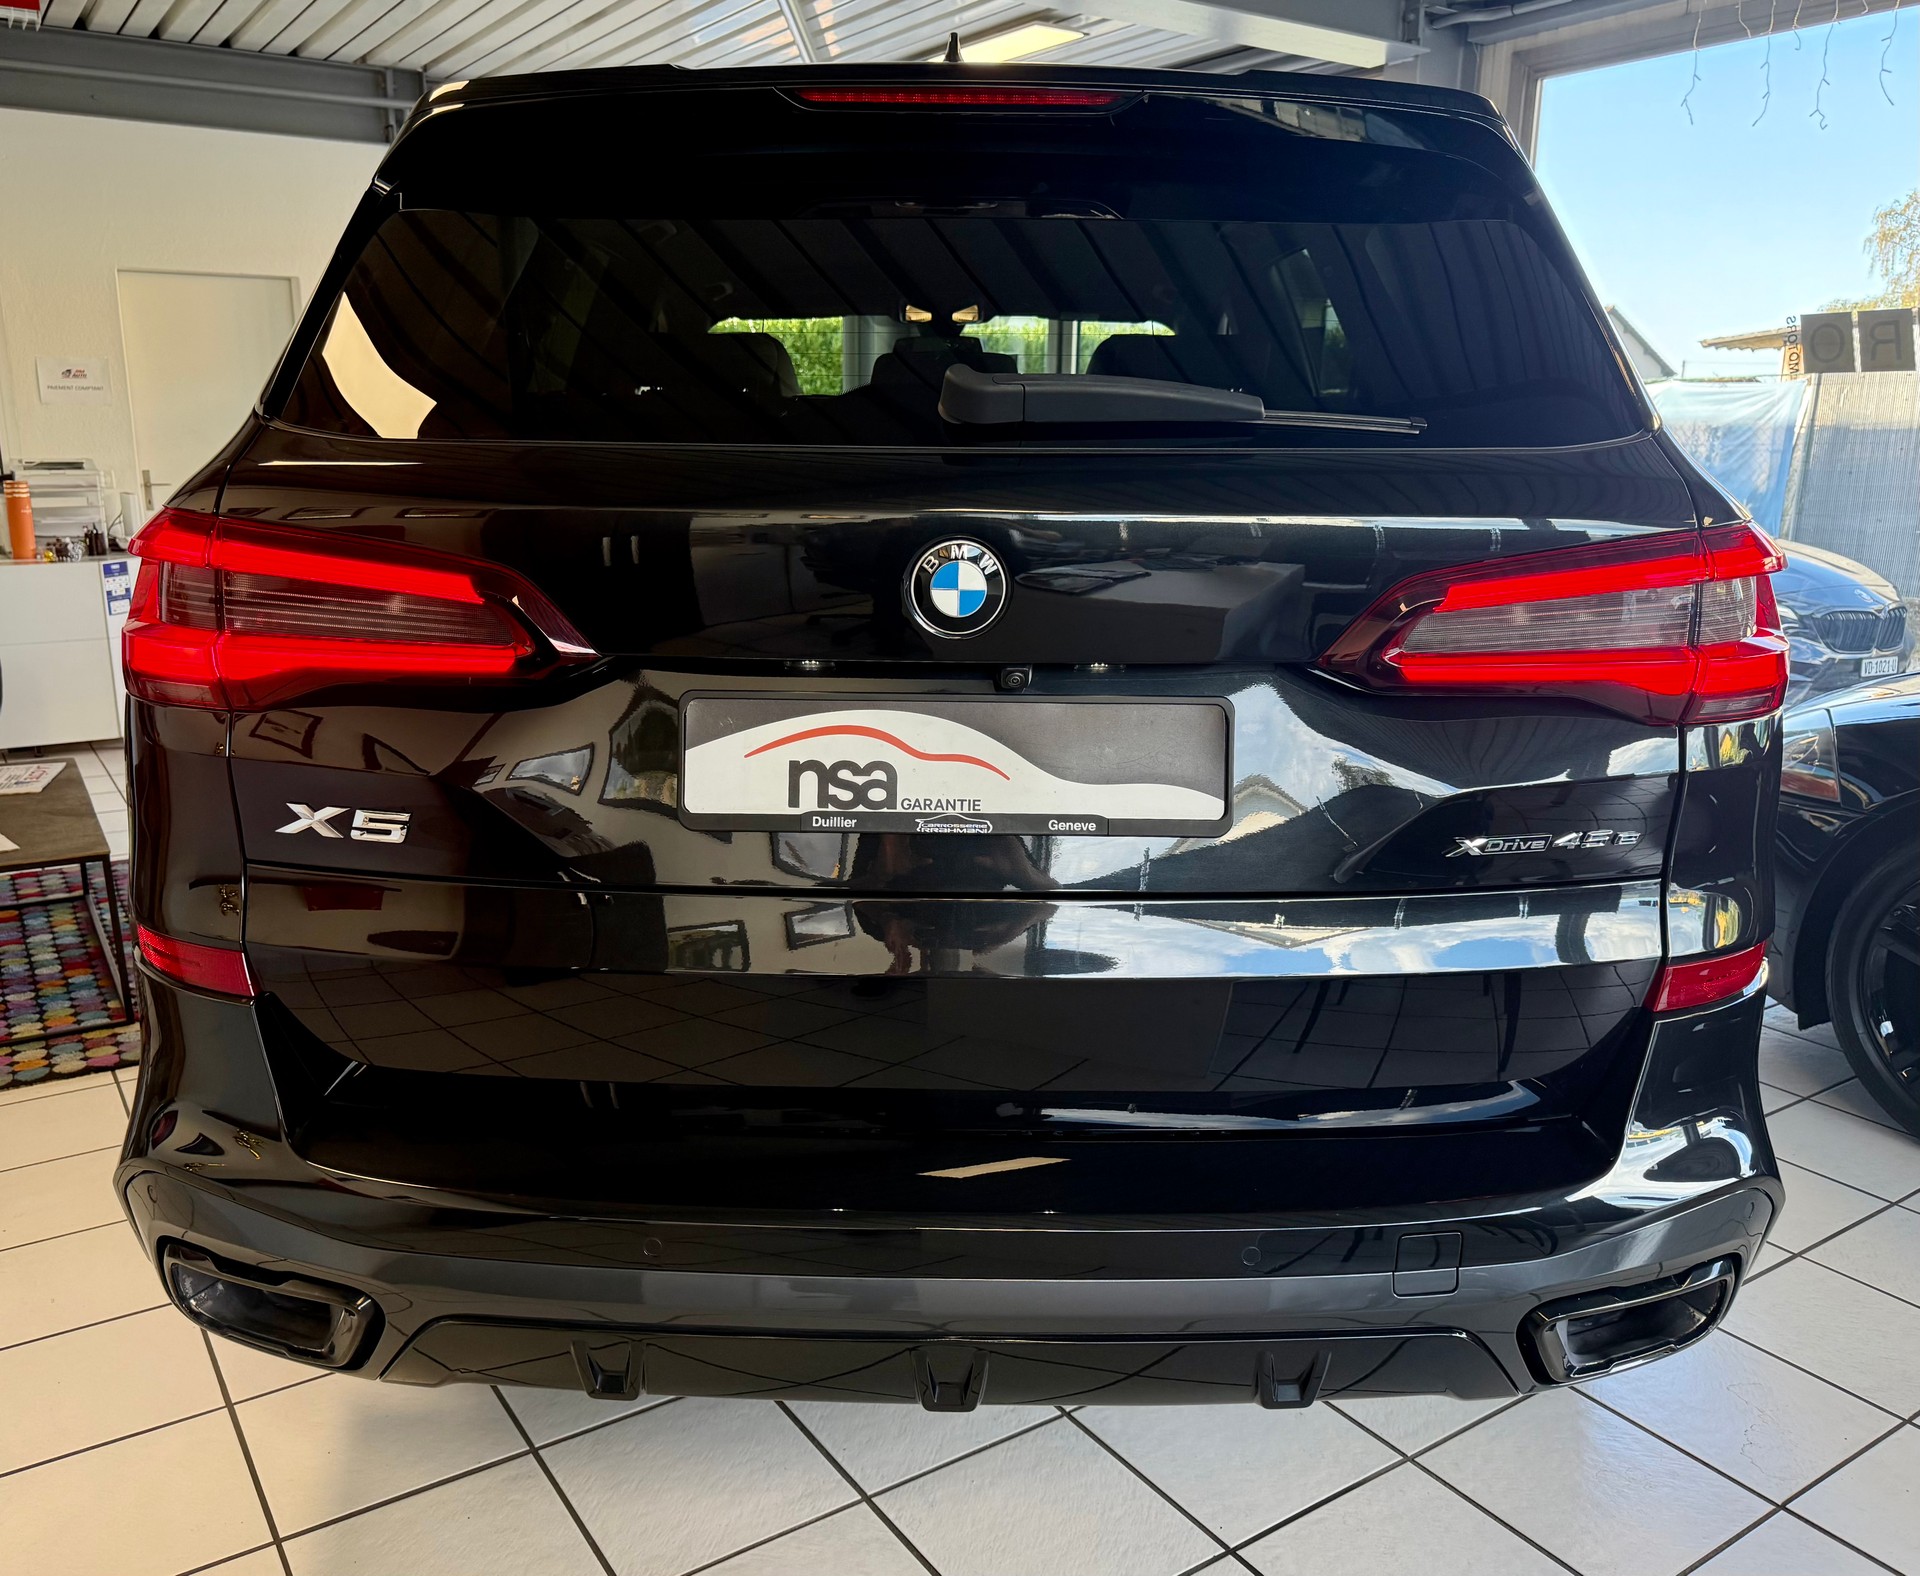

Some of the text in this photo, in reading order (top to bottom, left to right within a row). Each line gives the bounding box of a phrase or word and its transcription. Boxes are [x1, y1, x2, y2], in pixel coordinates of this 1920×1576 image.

[922, 544, 998, 576] BMW
[788, 759, 898, 811] nsa
[900, 797, 982, 812] GARANTIE
[275, 803, 411, 844] X5
[812, 816, 857, 828] Duillier
[1048, 819, 1097, 832] Geneve
